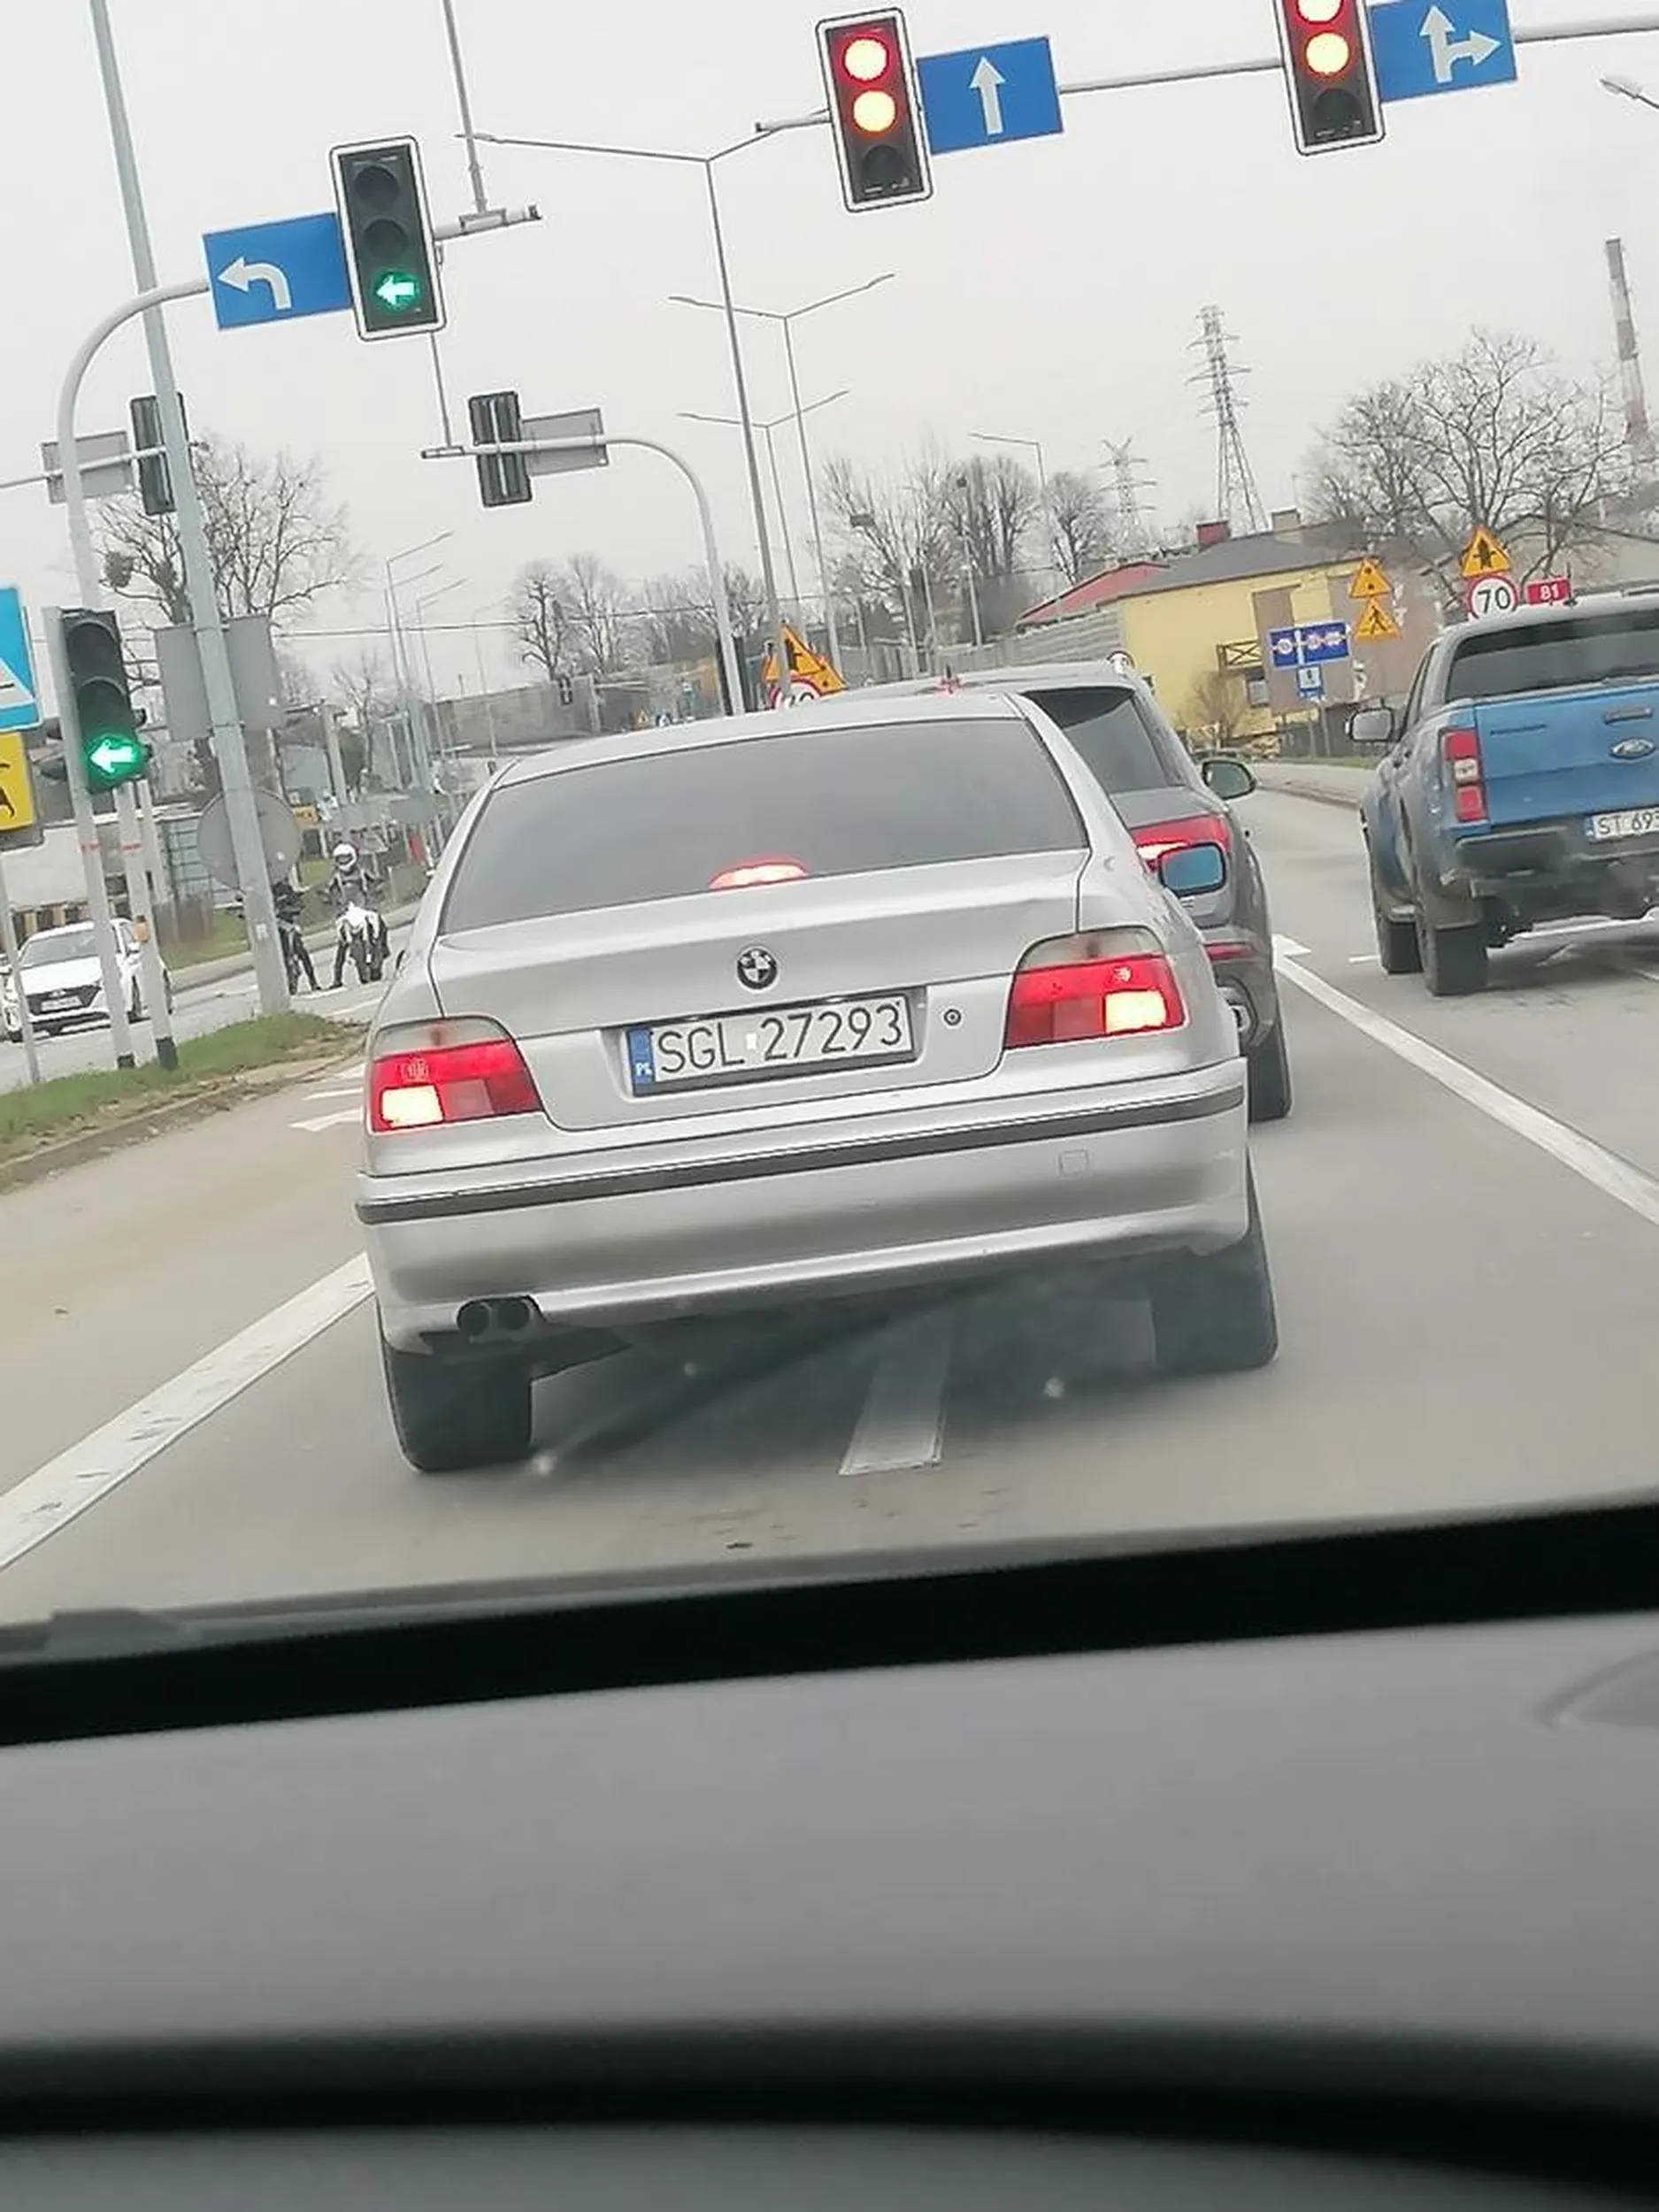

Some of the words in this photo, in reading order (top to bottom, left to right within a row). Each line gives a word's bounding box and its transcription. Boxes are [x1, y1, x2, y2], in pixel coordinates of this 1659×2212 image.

[1477, 586, 1511, 614] 70
[1540, 583, 1560, 601] 81
[1597, 814, 1622, 834] ST
[658, 1023, 745, 1073] SGL
[761, 1003, 902, 1061] 27293
